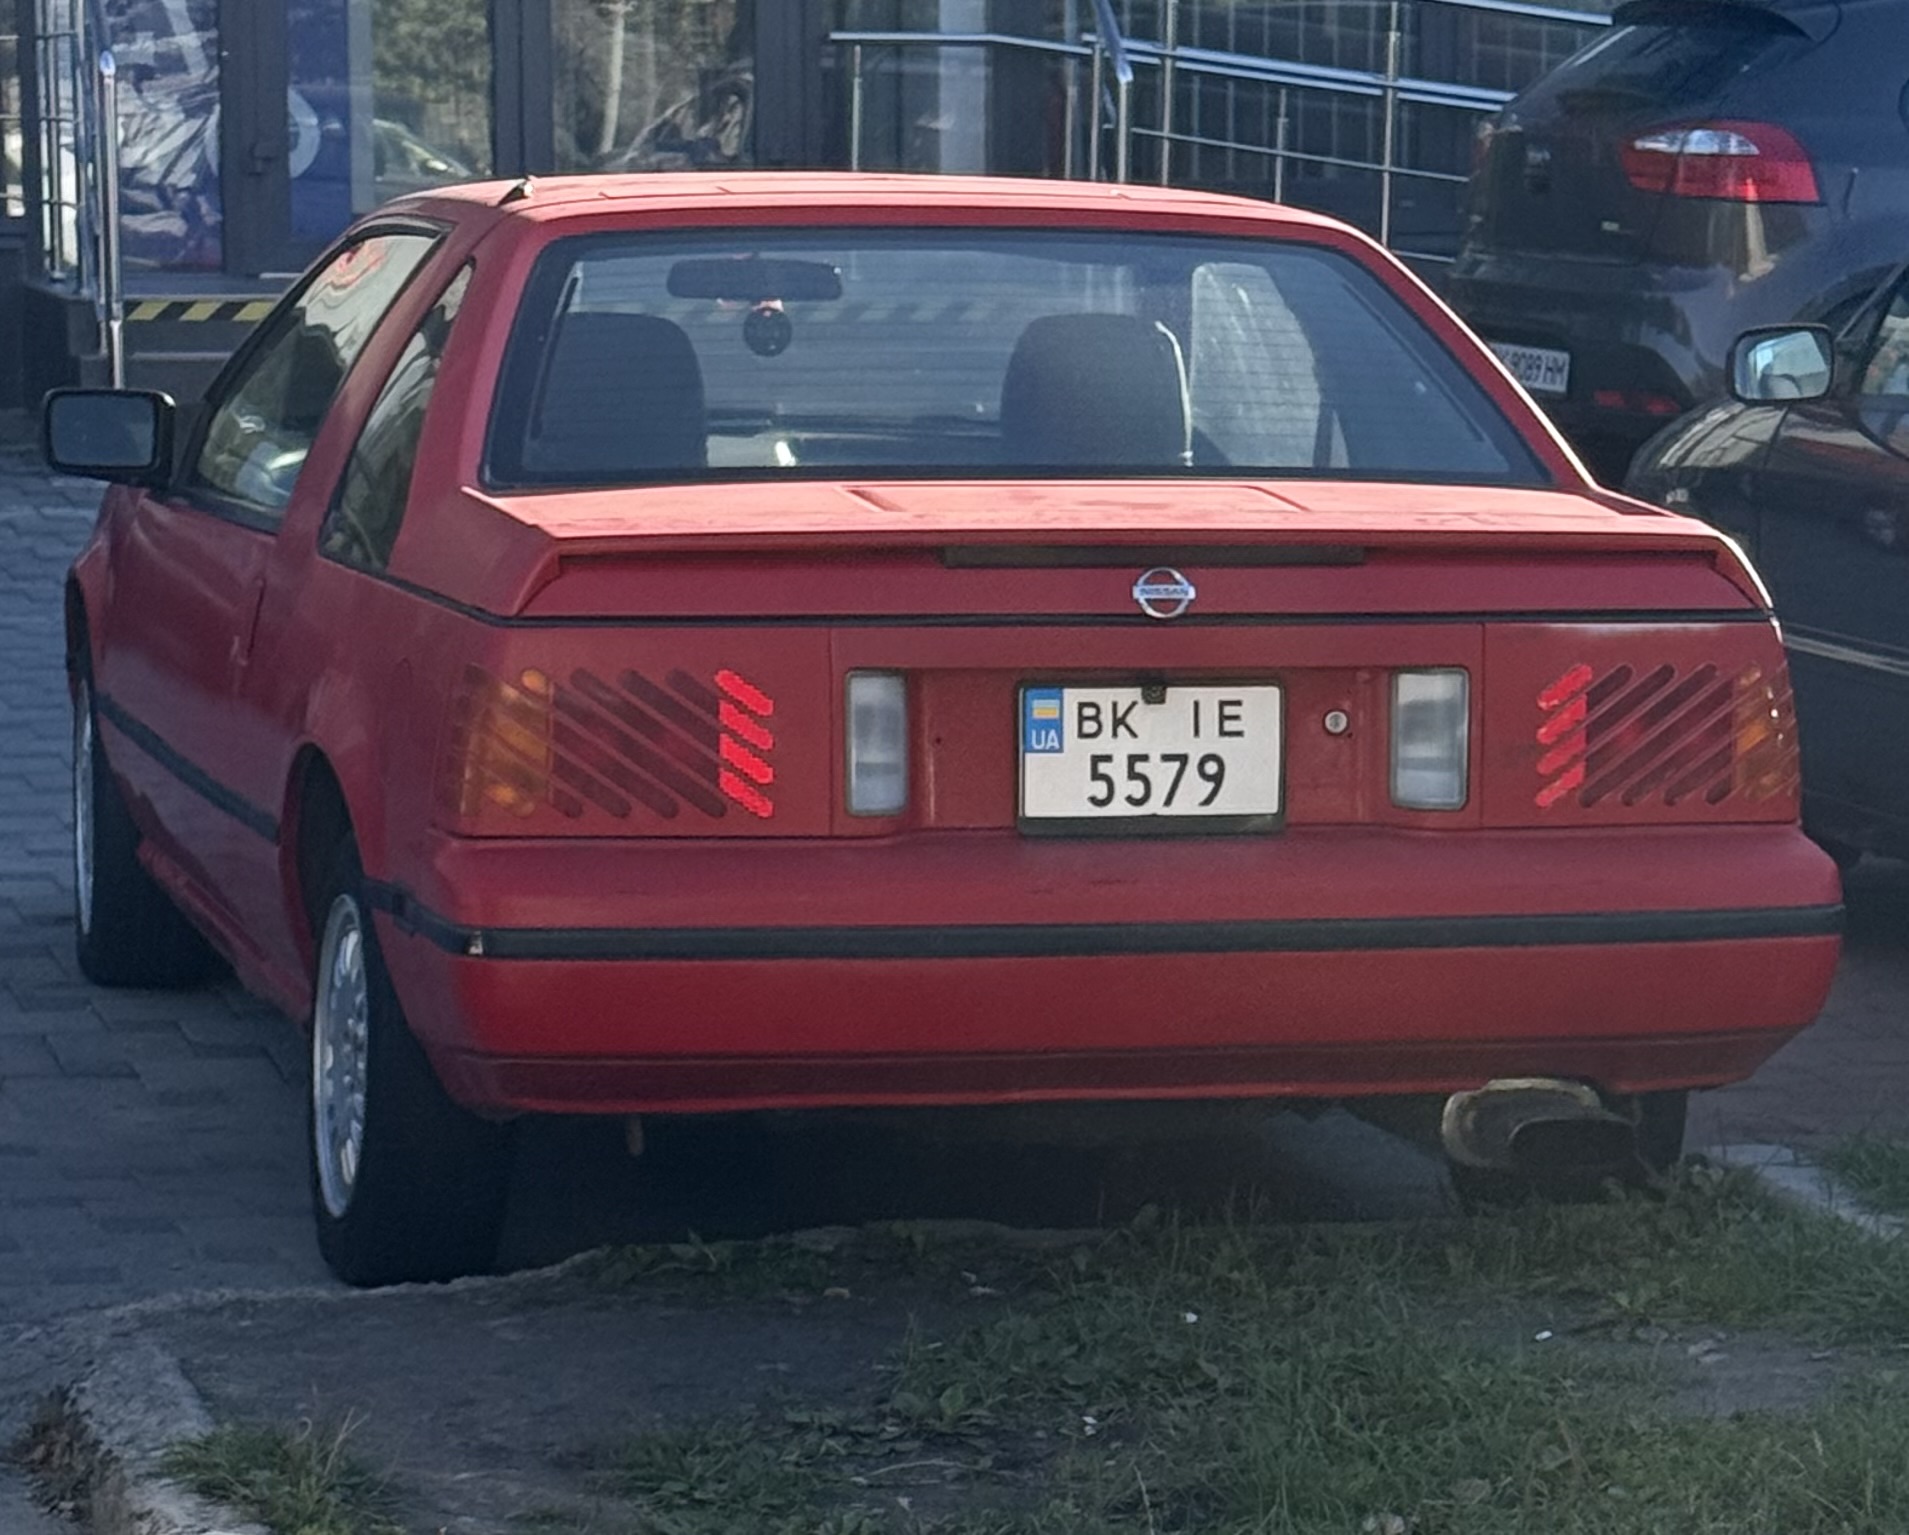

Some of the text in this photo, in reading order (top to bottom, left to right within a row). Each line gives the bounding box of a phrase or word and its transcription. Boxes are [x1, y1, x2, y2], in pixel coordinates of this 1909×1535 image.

[1076, 700, 1245, 739] BK IE
[1030, 729, 1060, 750] UA
[1087, 753, 1226, 808] 5579
